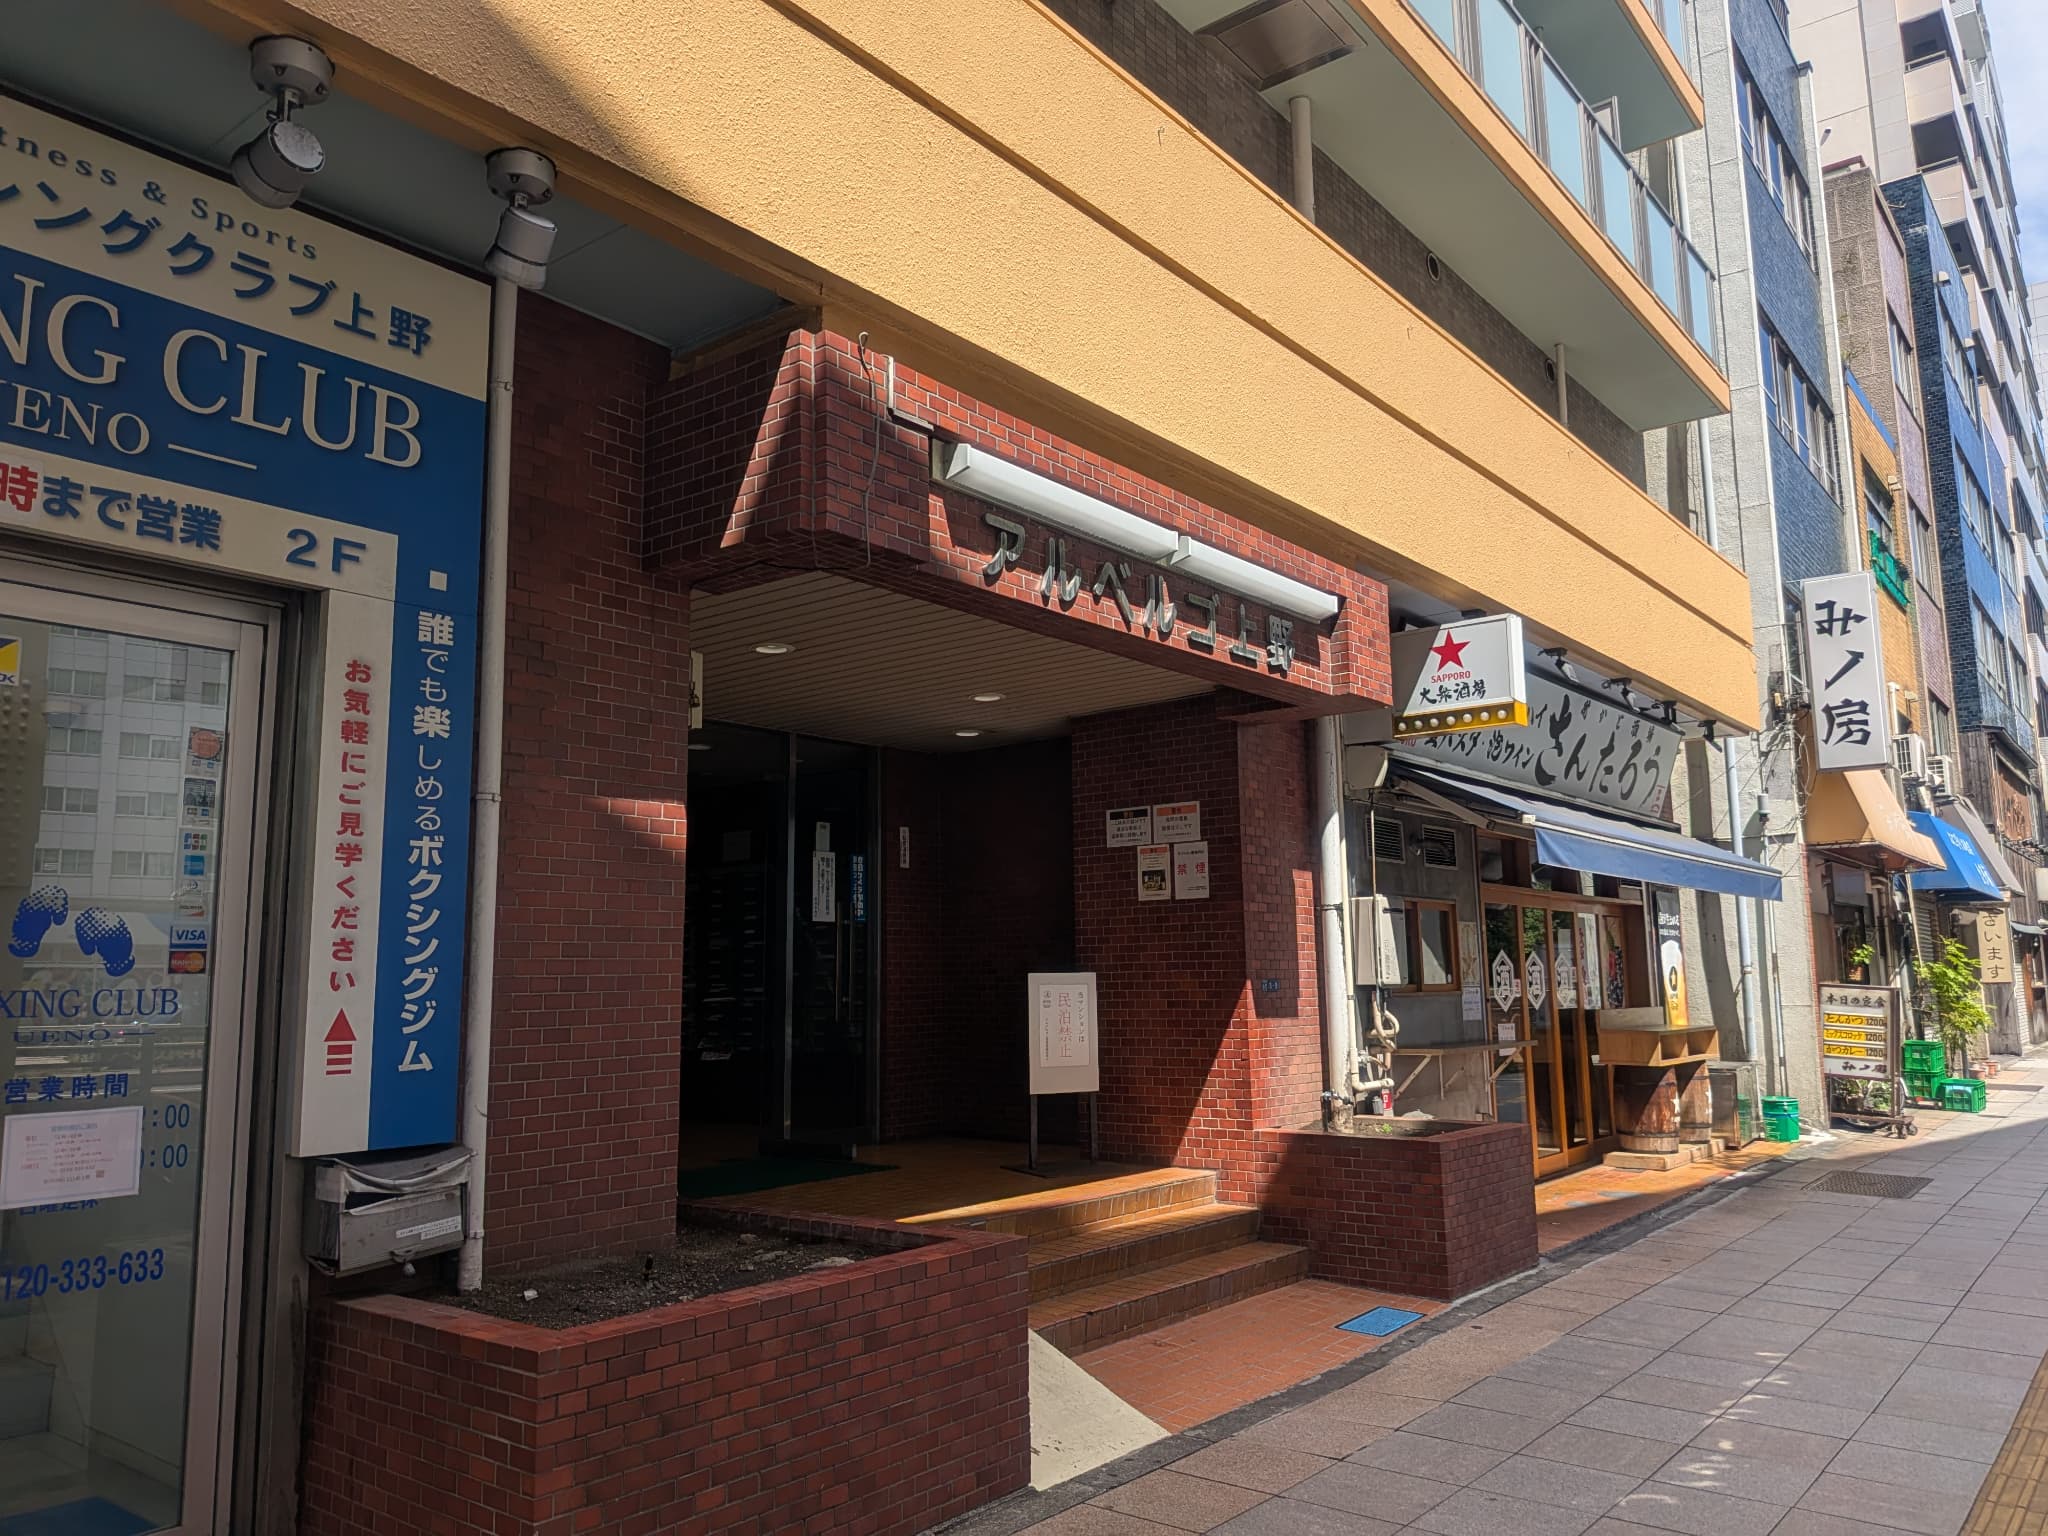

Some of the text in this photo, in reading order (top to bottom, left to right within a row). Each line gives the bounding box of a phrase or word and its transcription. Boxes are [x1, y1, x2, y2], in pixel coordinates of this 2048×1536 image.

[142, 181, 167, 205] &
[191, 197, 317, 260] Sports
[0, 180, 432, 357] ングクラブ上野
[0, 378, 150, 455] ENO
[163, 329, 423, 468] CLUB
[285, 528, 367, 574] 2F
[982, 512, 1296, 673] アルベルゴ上野
[1419, 679, 1487, 705] 大衆酒場
[1431, 670, 1472, 684] SAPPORO
[329, 659, 373, 993] お気軽にご見学ください
[397, 611, 455, 1073] 誰でも楽しめるボクシングジム
[176, 929, 206, 941] VISA
[92, 988, 179, 1017] CLUB
[1826, 1014, 1864, 1025] とんかつ
[12, 1028, 111, 1043] UENO
[1057, 991, 1073, 1058] 民泊禁止
[5, 1073, 129, 1105] 営業時間
[142, 1103, 190, 1131] :00
[140, 1143, 188, 1169] :00
